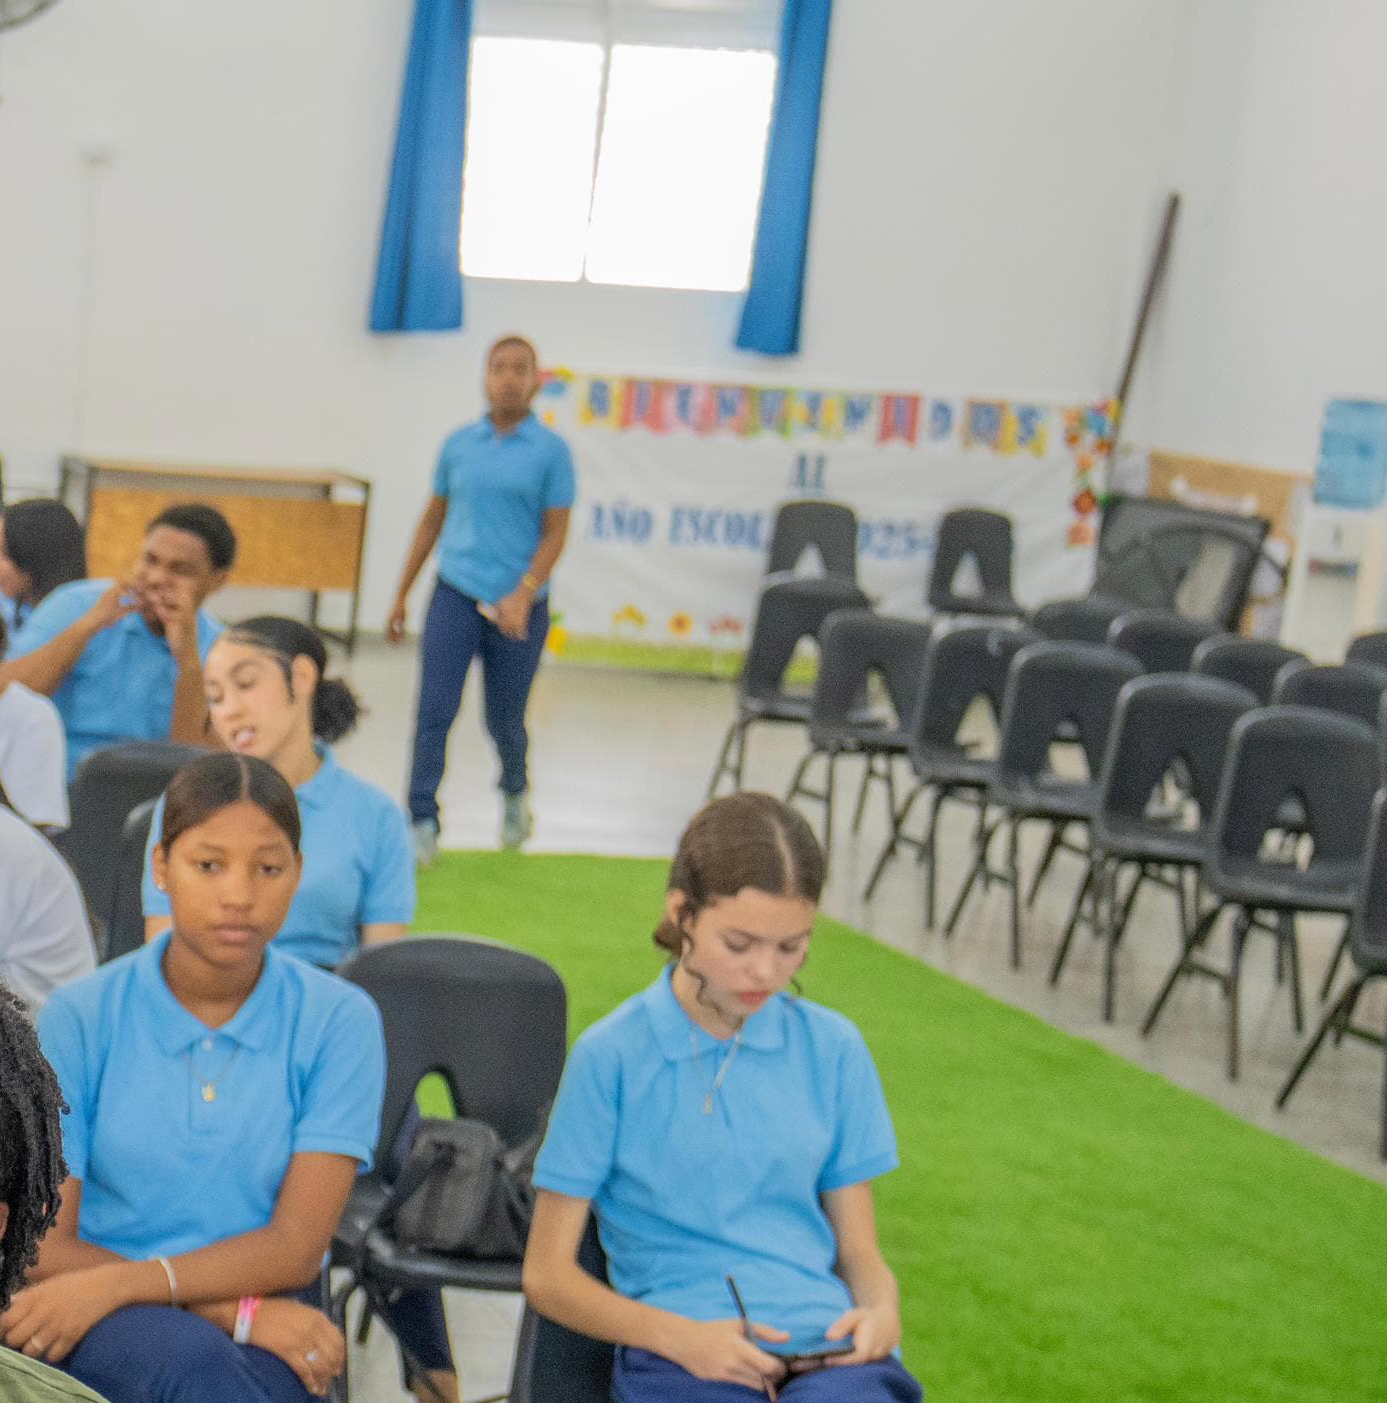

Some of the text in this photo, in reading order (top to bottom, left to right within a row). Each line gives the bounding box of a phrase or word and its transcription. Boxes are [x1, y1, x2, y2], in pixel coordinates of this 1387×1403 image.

[588, 378, 1043, 447] BIENVENIDOS
[588, 496, 653, 546] AÑO
[667, 505, 772, 550] ESCOL
